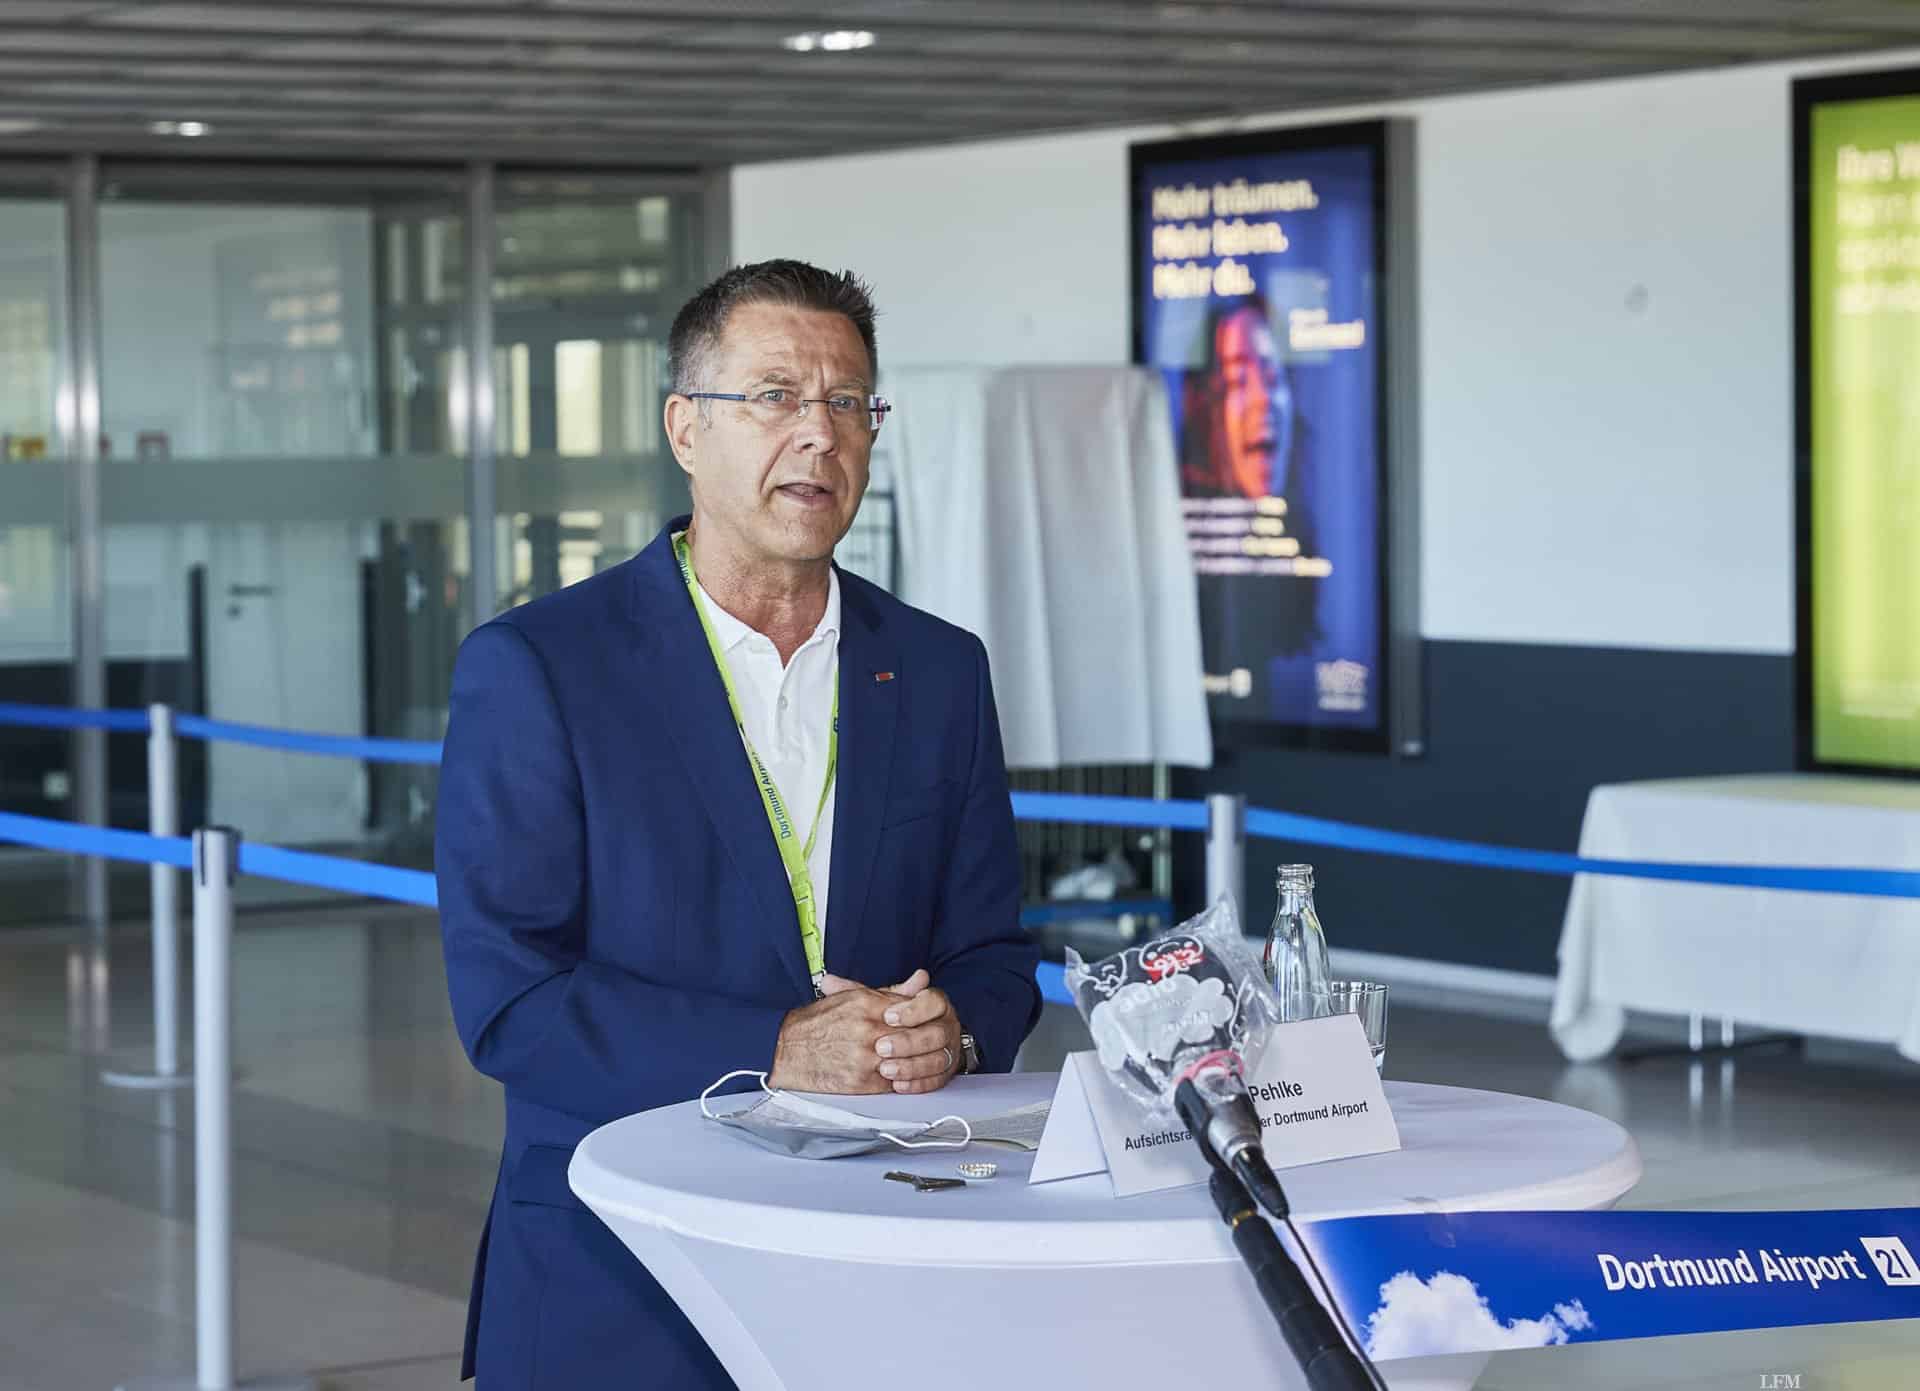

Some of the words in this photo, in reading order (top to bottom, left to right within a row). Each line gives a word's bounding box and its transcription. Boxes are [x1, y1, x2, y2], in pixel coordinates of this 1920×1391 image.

[765, 787, 791, 839] Dortmund
[1248, 1080, 1303, 1103] Pehlke
[1125, 1130, 1193, 1151] Aufsichtsra
[1274, 1105, 1329, 1126] Dortmund
[1331, 1100, 1369, 1119] Airport
[1597, 1250, 1759, 1291] Dortmund
[1759, 1248, 1867, 1290] Airport
[1874, 1249, 1912, 1280] 21
